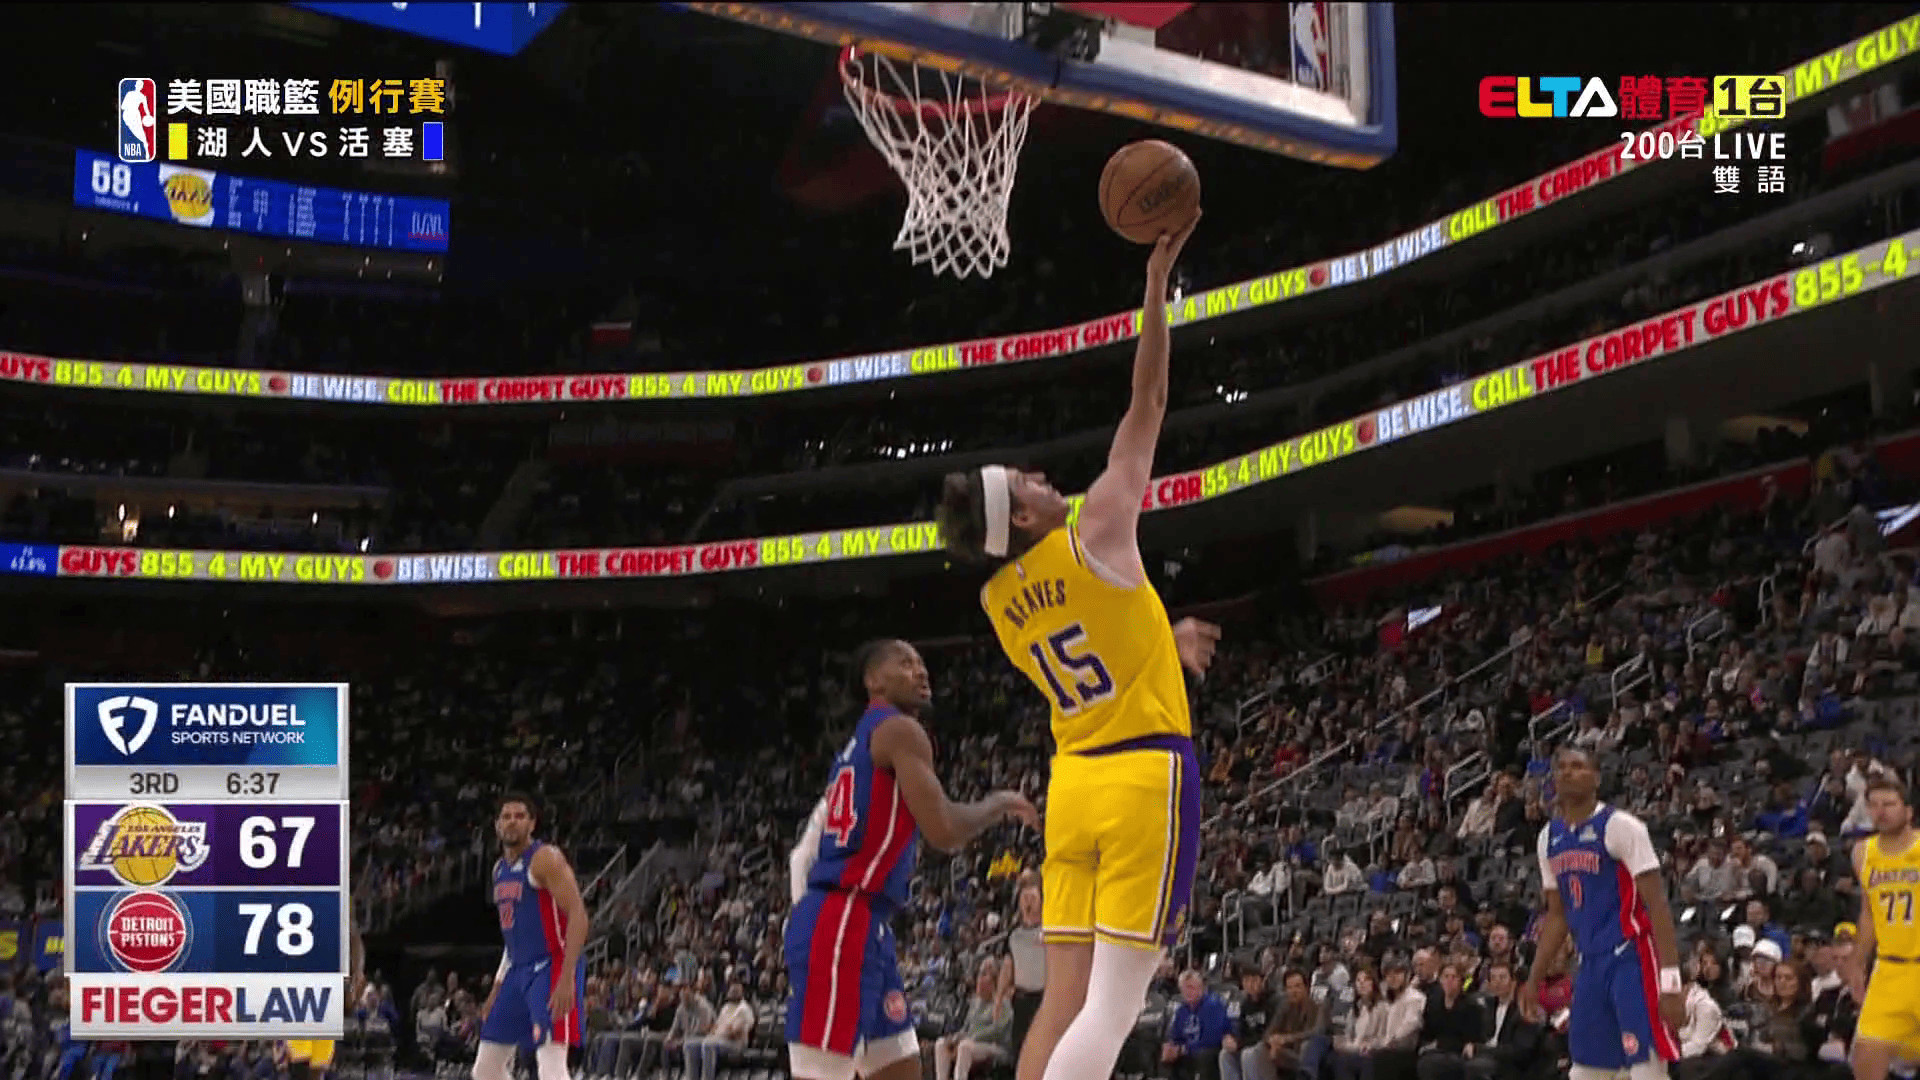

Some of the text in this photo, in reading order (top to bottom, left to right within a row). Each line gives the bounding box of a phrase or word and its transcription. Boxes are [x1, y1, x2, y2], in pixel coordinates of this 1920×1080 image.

[1449, 199, 1498, 242] CALL
[1497, 180, 1535, 221] THE
[1539, 140, 1626, 202] CARPET
[387, 379, 439, 405] CALL
[441, 378, 479, 403] THE
[483, 376, 564, 403] CARPET
[569, 374, 626, 400] GUYS
[911, 345, 958, 375] CALL
[959, 341, 997, 367] THE
[1001, 328, 1080, 361] CARPET
[1083, 312, 1134, 346] GUYS
[1377, 406, 1405, 442] BE
[1406, 386, 1470, 430] WISE.
[1472, 367, 1533, 412] CALL
[1532, 347, 1582, 392] THE
[1585, 308, 1699, 374] CARPET
[1703, 275, 1791, 336] GUYS
[60, 546, 139, 577] GUYS
[398, 557, 429, 582] BE
[430, 554, 492, 581] WISE.
[497, 552, 556, 579] CALL
[557, 551, 600, 578] THE
[604, 547, 697, 577] CARPET
[699, 539, 759, 571] GUYS
[1029, 621, 1116, 716] 15
[1879, 888, 1914, 923] 77
